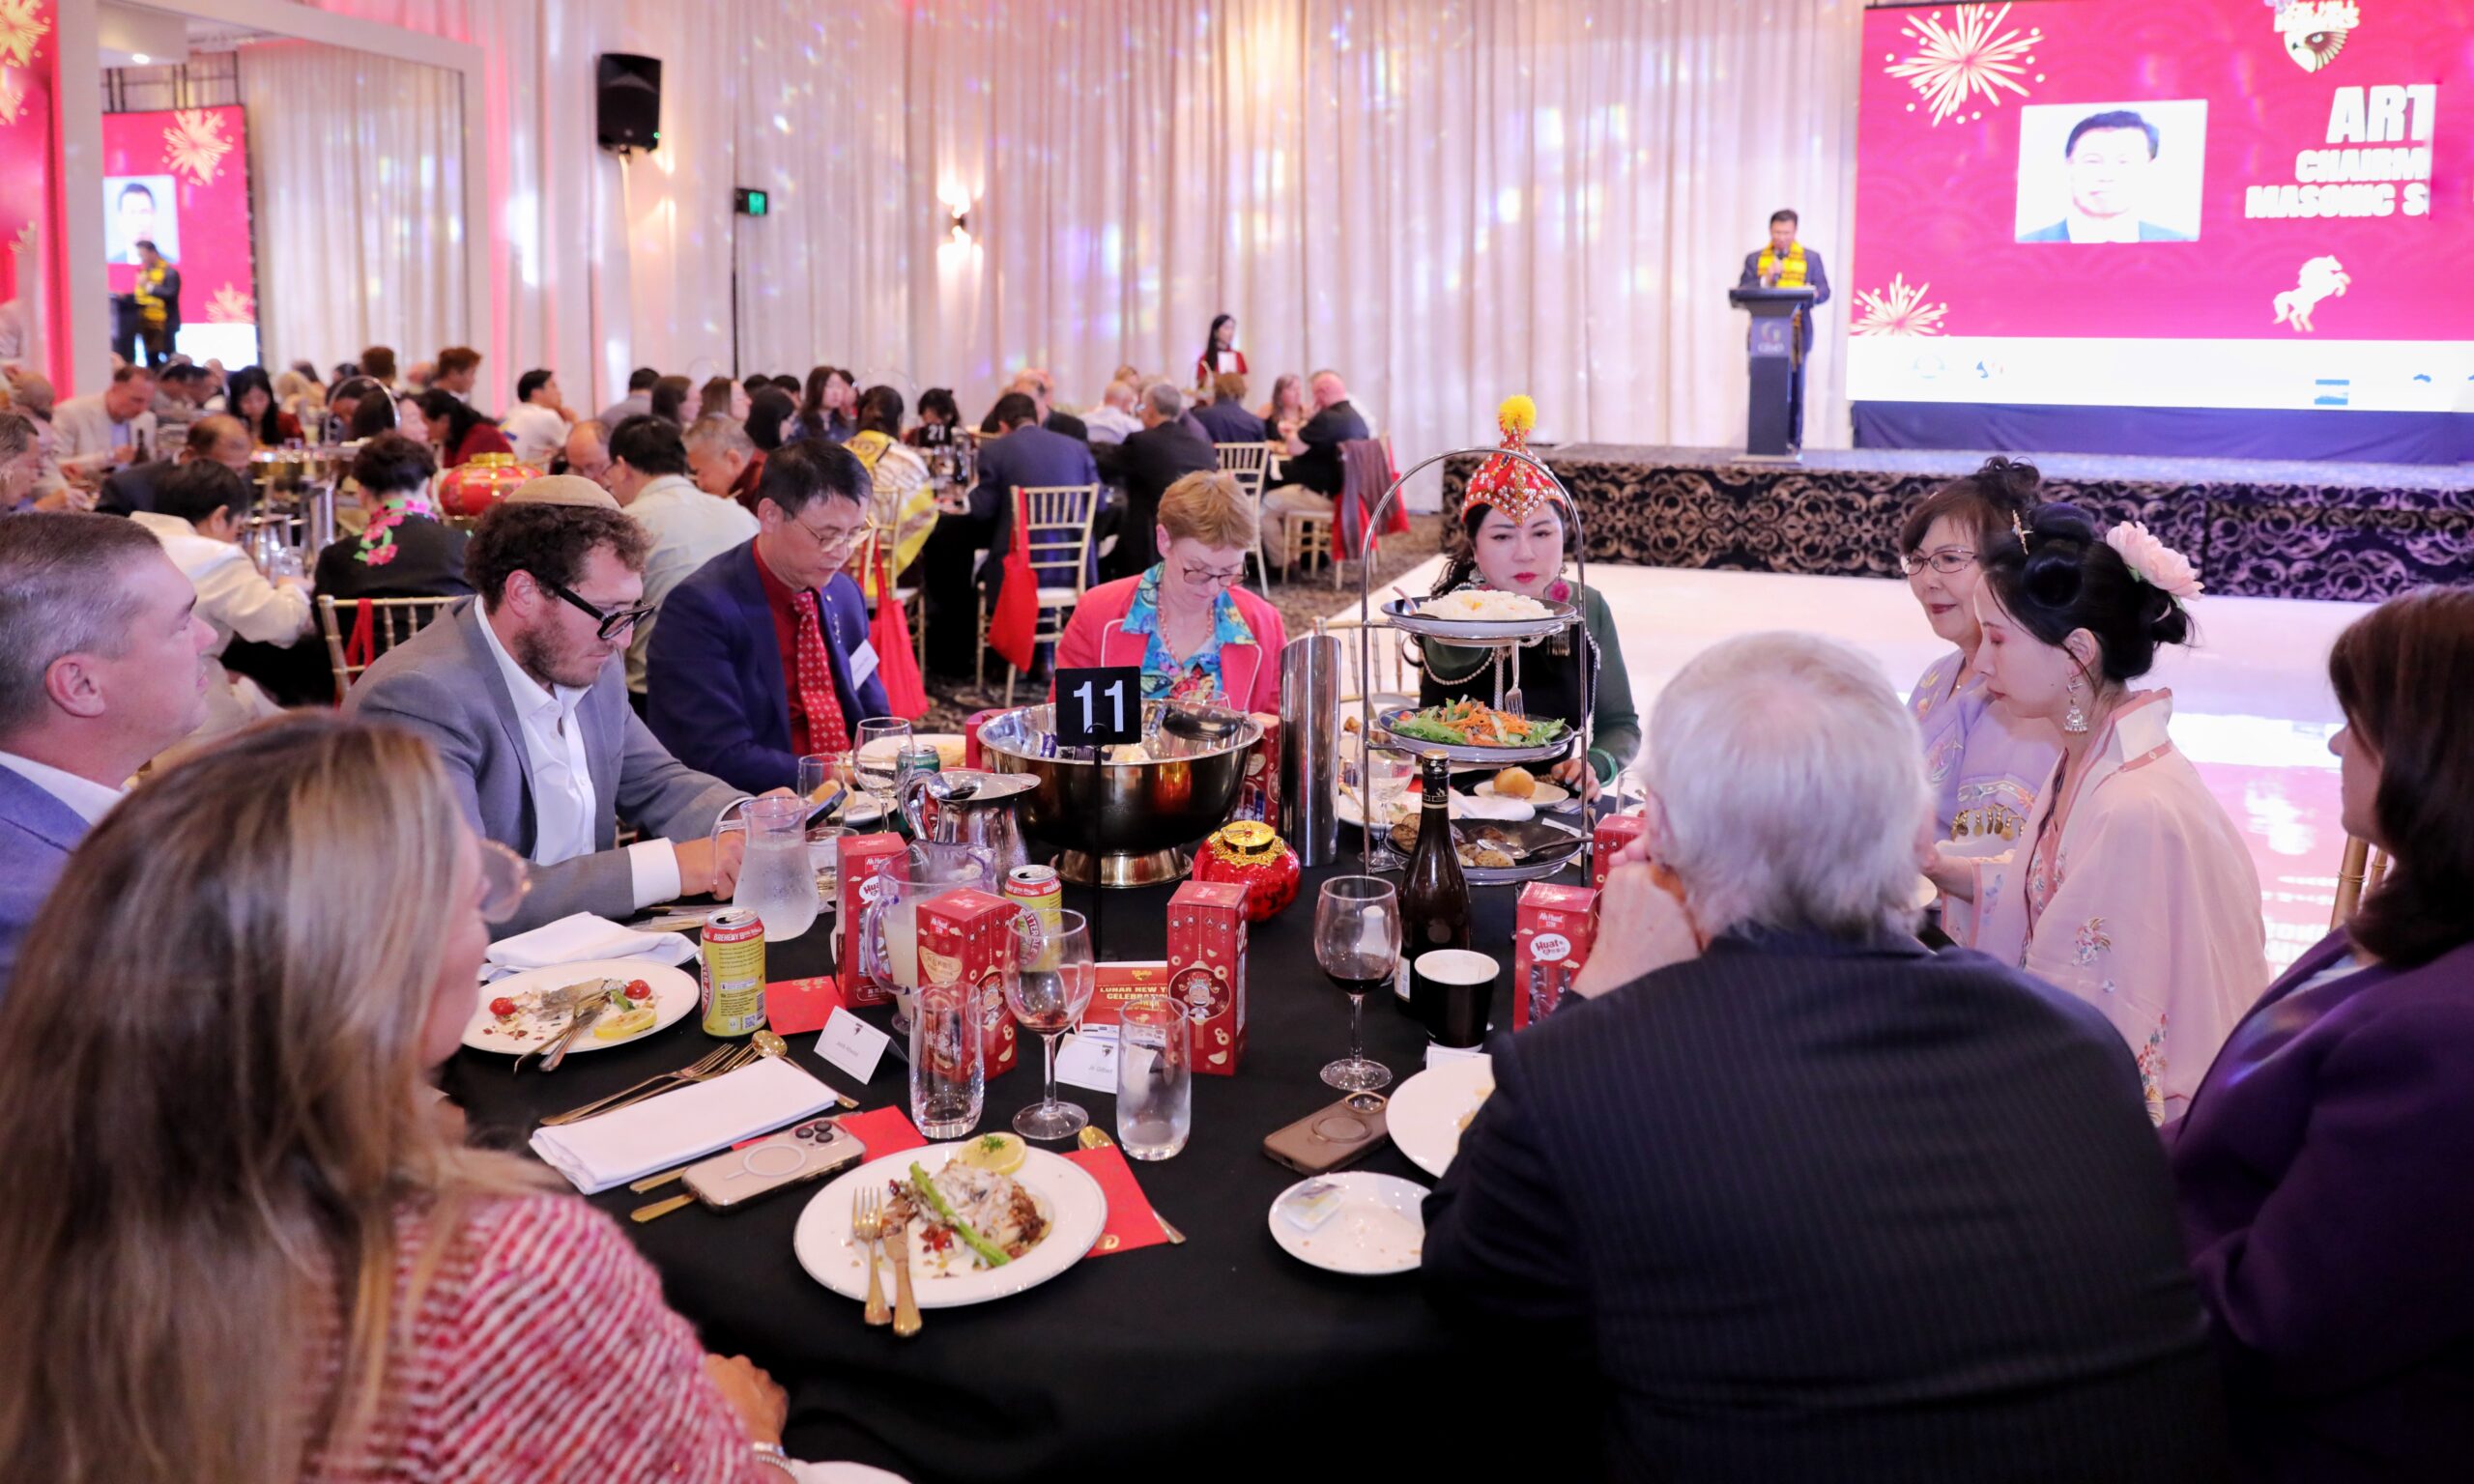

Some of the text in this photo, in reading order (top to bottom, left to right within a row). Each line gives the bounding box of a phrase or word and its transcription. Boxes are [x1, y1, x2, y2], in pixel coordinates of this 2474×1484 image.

[2244, 182, 2430, 219] MASONIC S
[928, 424, 945, 442] 21
[1073, 679, 1124, 734] 11
[1535, 939, 1560, 952] Huat
